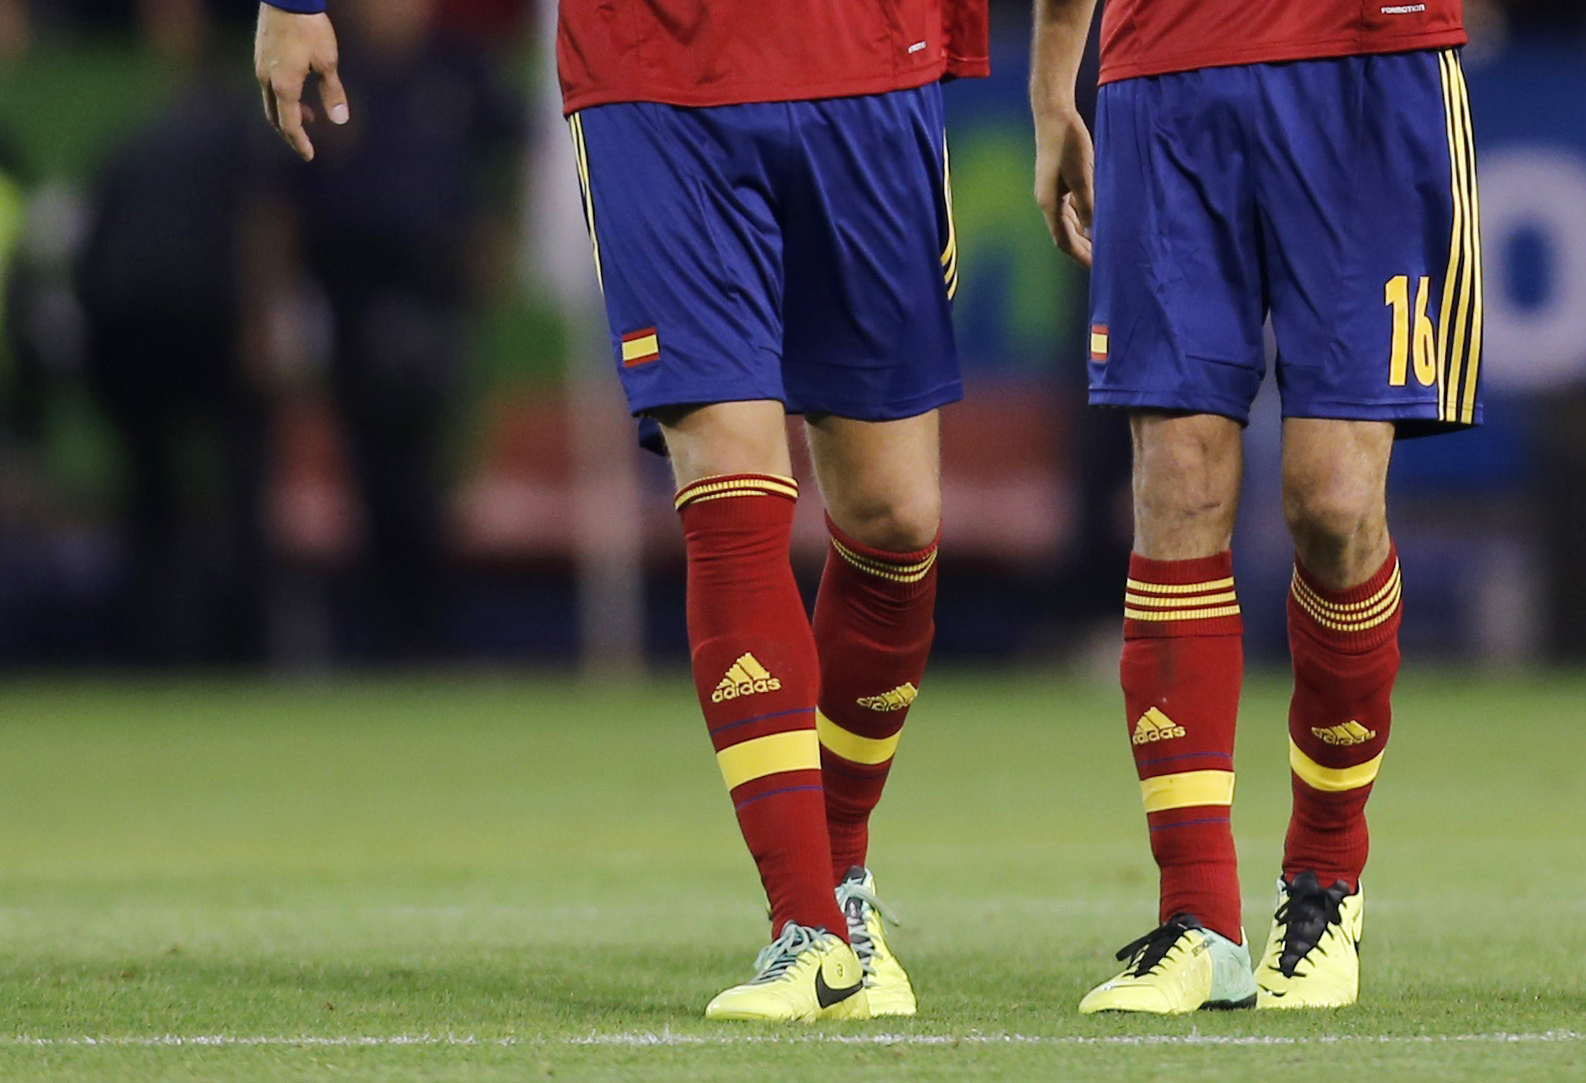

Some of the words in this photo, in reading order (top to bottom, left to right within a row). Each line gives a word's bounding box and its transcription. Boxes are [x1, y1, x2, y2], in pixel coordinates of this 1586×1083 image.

[1385, 275, 1437, 386] 16
[711, 677, 782, 703] adidas
[1311, 727, 1376, 746] adidas
